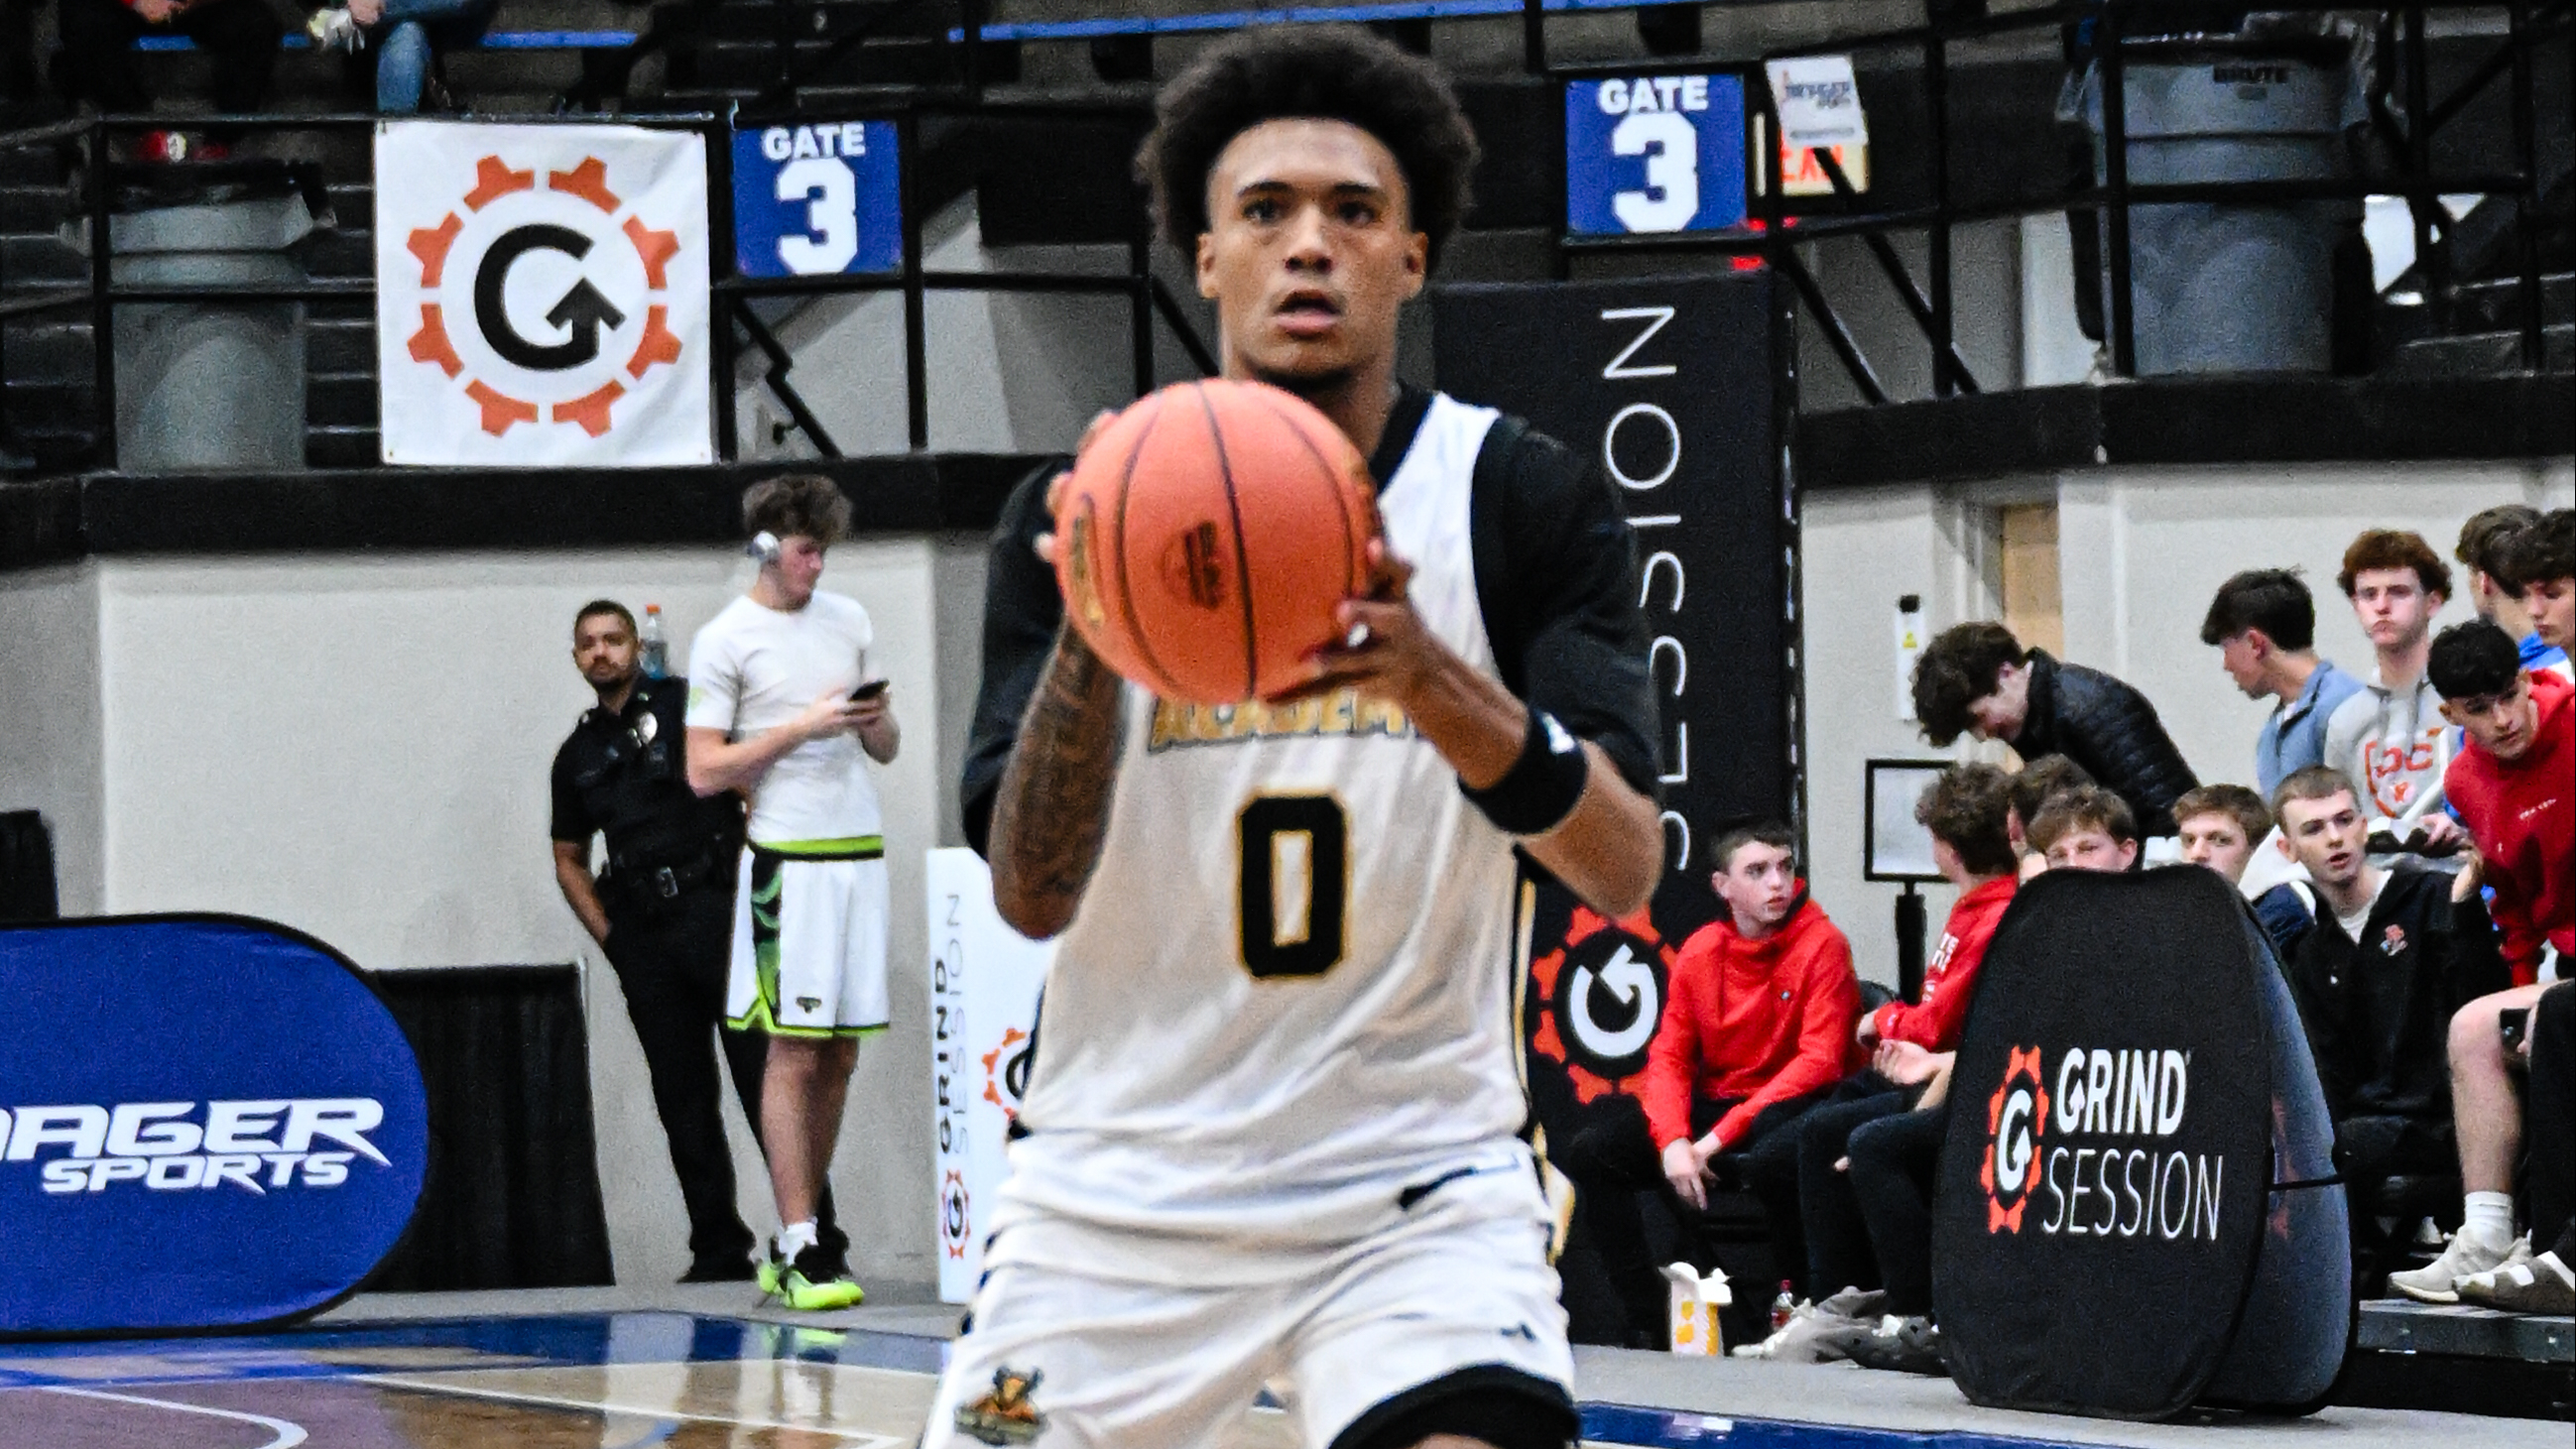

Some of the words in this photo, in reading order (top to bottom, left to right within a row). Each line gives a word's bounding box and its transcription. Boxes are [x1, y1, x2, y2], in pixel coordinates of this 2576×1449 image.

[1598, 74, 1710, 115] GATE
[761, 123, 866, 161] GATE
[1612, 110, 1700, 234] 3
[774, 156, 859, 276] 3
[1235, 788, 1350, 981] 0
[0, 1097, 393, 1167] AGER
[2056, 1046, 2187, 1137] GRIND
[42, 1152, 355, 1195] SPORTS
[2041, 1146, 2224, 1241] SESSION
